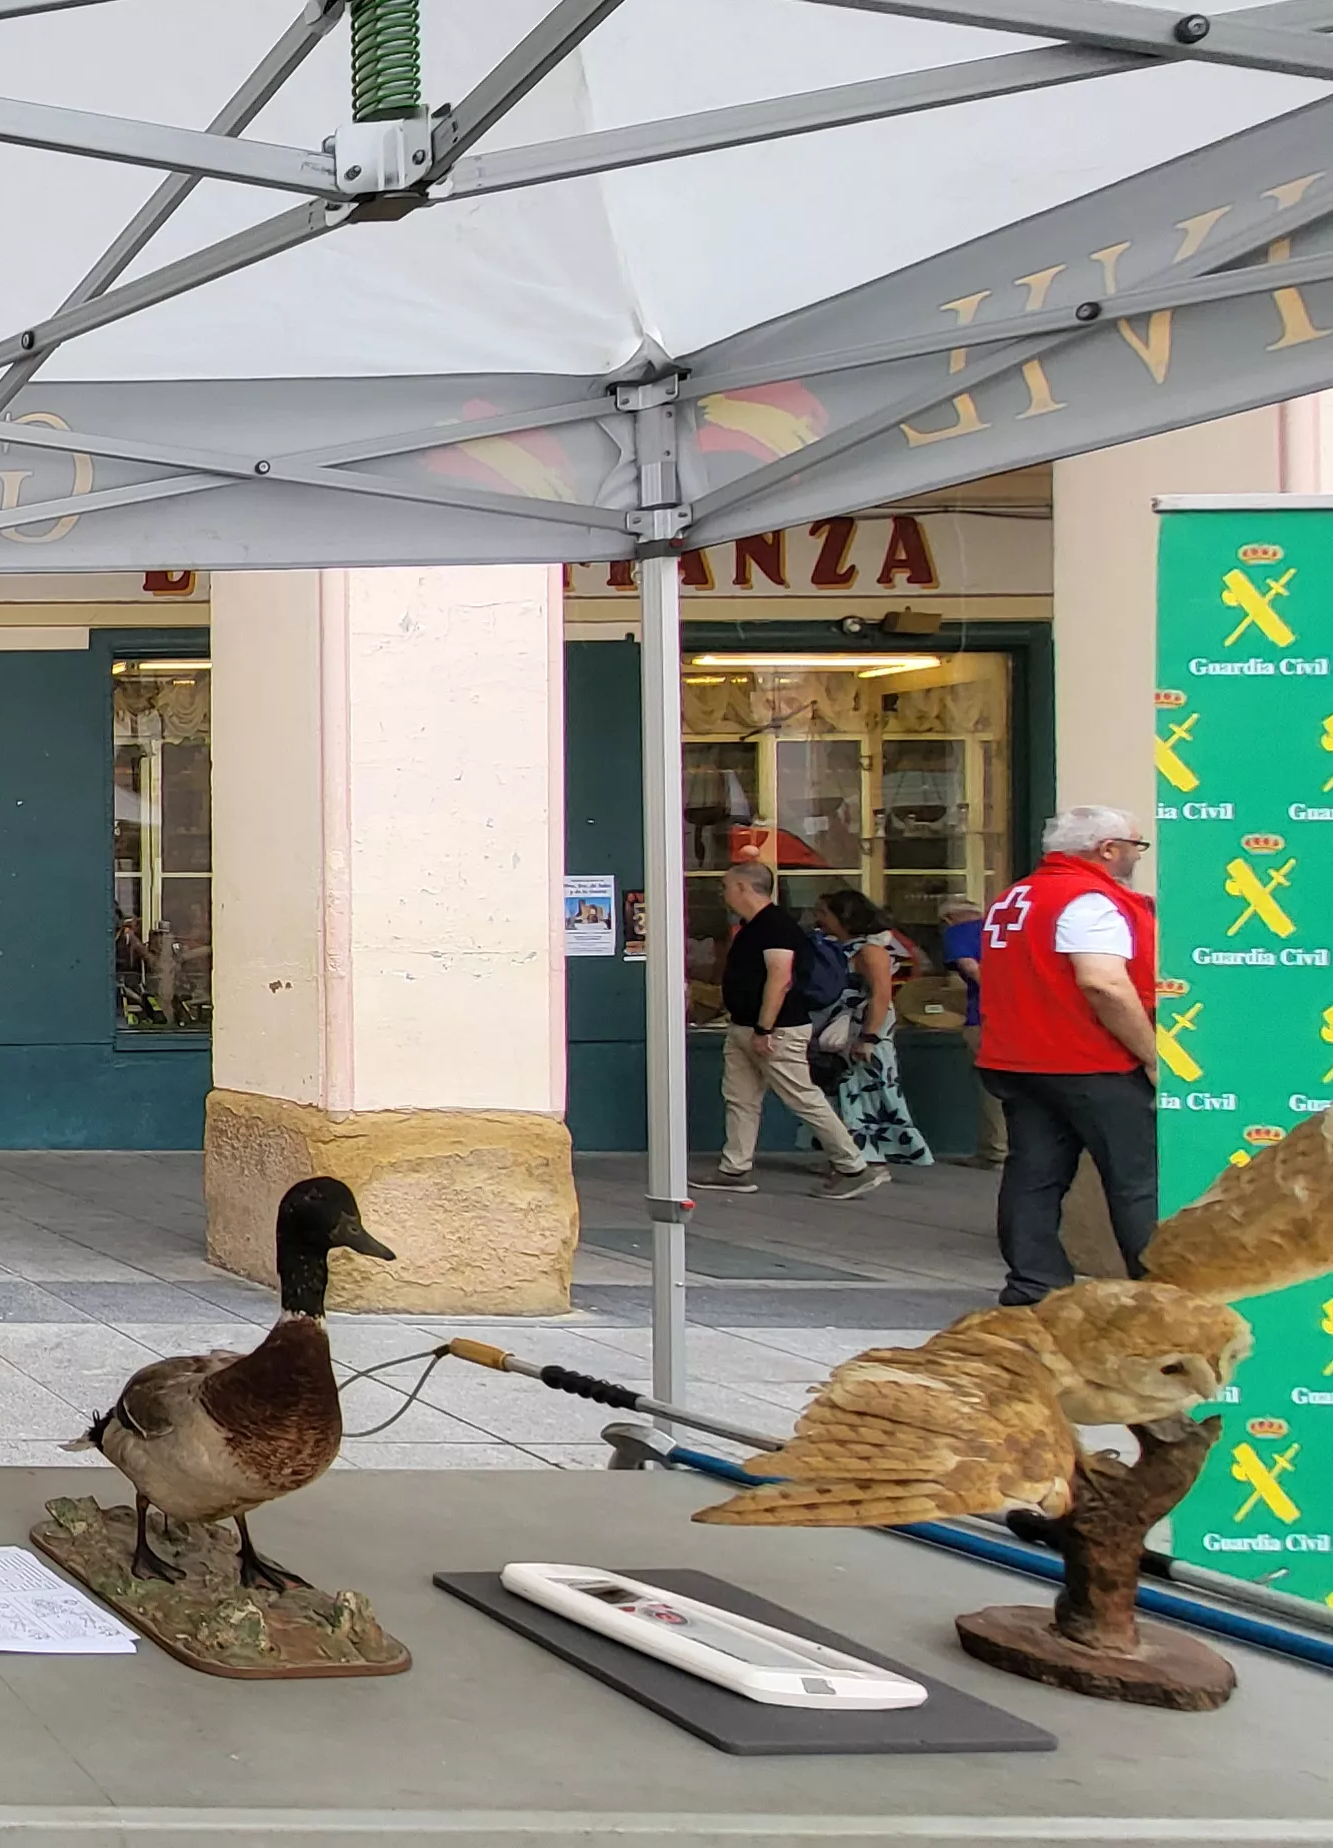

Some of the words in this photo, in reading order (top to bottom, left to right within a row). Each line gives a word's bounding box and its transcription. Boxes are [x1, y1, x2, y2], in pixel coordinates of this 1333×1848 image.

[1189, 658, 1275, 675] Guardia
[1279, 658, 1328, 675] Civil
[1183, 802, 1233, 820] Civil
[1192, 947, 1276, 965] Guardia
[1280, 948, 1329, 966] Civil
[1186, 1092, 1236, 1110] Civil
[1202, 1533, 1282, 1551] Guardia
[1285, 1533, 1331, 1551] Civil
